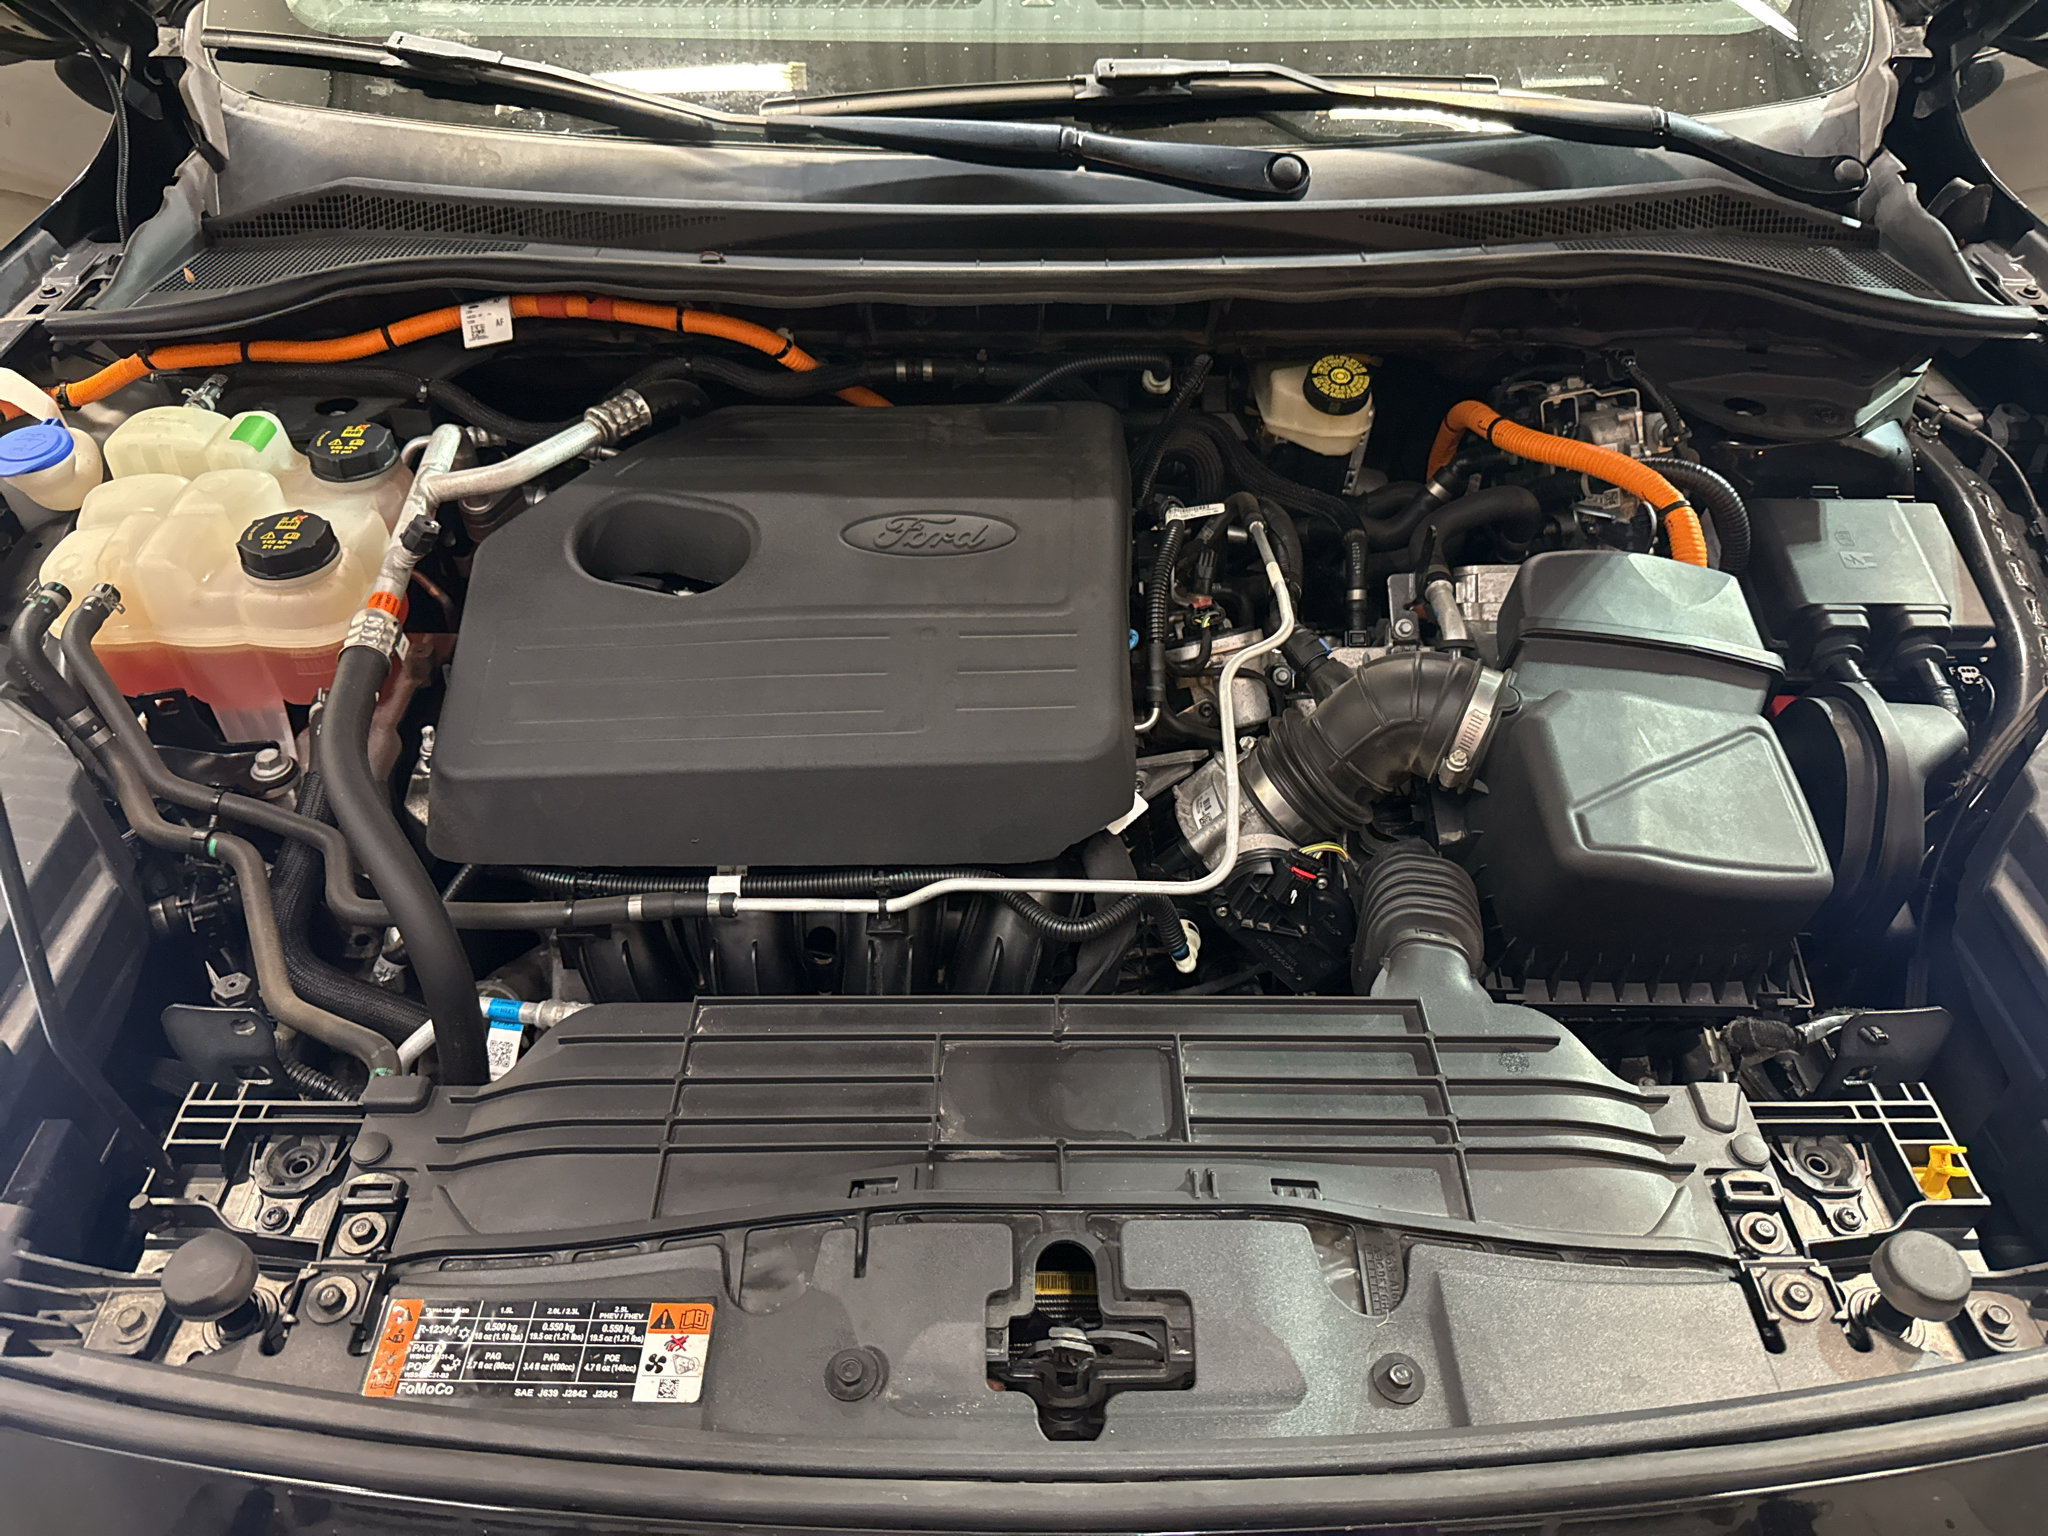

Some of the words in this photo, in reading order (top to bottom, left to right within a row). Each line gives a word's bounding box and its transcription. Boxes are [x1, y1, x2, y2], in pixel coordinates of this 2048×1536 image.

[873, 517, 989, 549] Ford
[419, 1324, 460, 1336] R-1234yf
[484, 1323, 506, 1331] 0.500
[507, 1323, 518, 1333] kg
[542, 1322, 564, 1332] 0.550
[564, 1323, 576, 1334] kg
[602, 1324, 624, 1333] 0.550
[624, 1324, 636, 1335] kg
[493, 1333, 510, 1342] (1.10
[553, 1333, 570, 1342] (1.21
[570, 1333, 584, 1342] lbs)
[613, 1334, 630, 1343] (1.21
[631, 1335, 644, 1344] lbs)
[412, 1344, 433, 1353] PAG
[485, 1352, 502, 1360] PAG
[543, 1353, 560, 1361] PAG
[604, 1354, 621, 1362] POE
[523, 1362, 534, 1371] 3.4
[550, 1363, 575, 1372] (100cc)
[584, 1363, 596, 1371] 4.7
[611, 1364, 636, 1373] (140cc)
[396, 1382, 454, 1395] FoMoCo
[514, 1388, 534, 1397] SAE
[537, 1388, 559, 1397] J639
[562, 1390, 588, 1398] J2842
[592, 1390, 618, 1398] J2845
